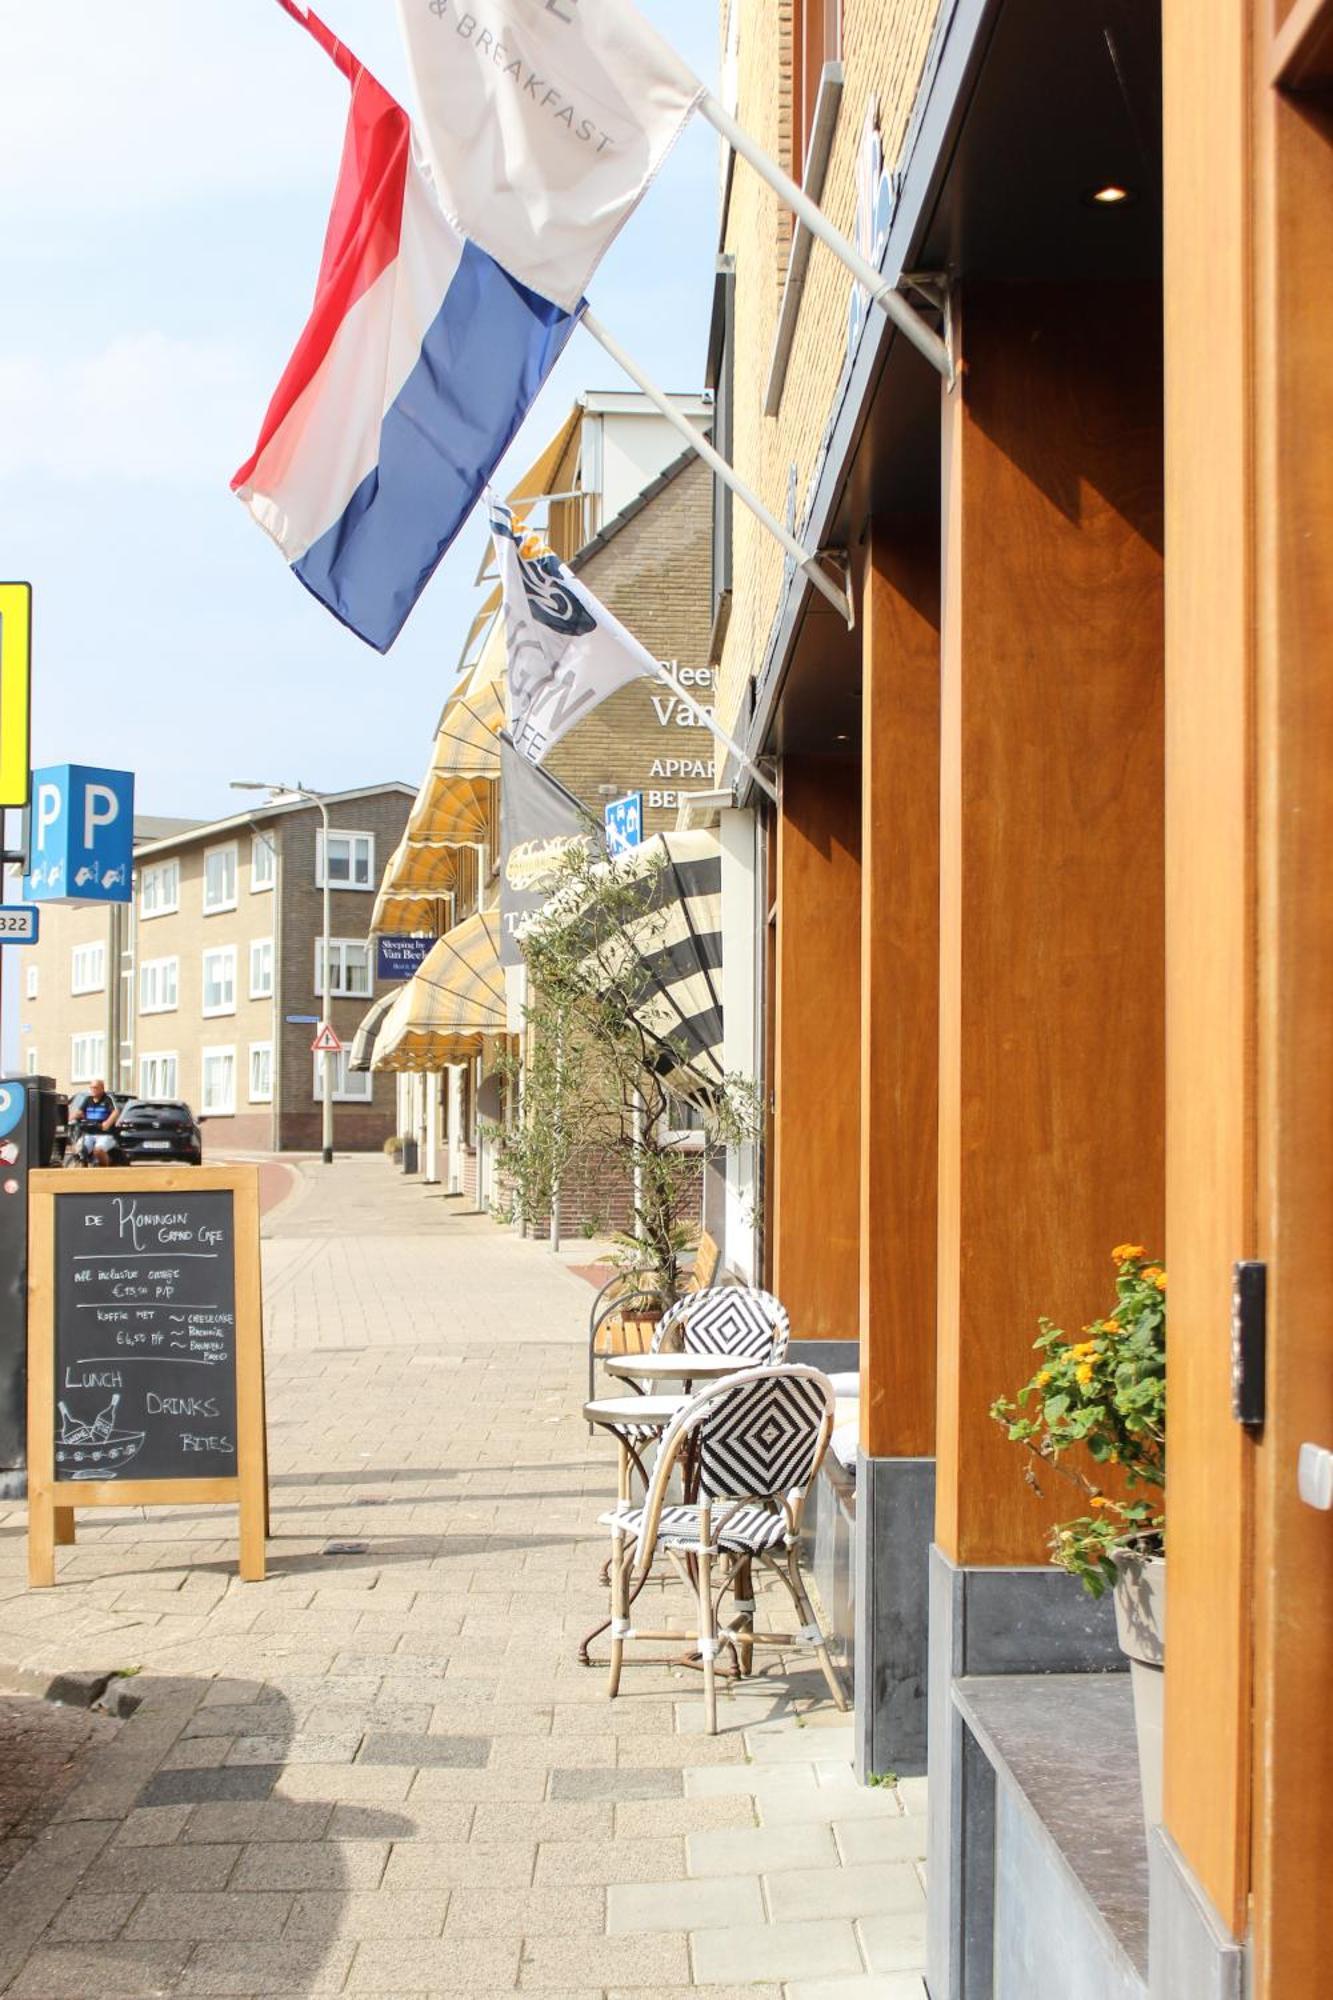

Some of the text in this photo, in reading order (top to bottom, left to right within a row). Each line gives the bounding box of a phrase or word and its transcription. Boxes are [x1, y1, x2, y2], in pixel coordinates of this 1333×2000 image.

[456, 13, 614, 152] BREAKFAST
[37, 783, 61, 851] P
[84, 783, 119, 849] P
[382, 948, 402, 960] Van
[84, 1197, 188, 1251] DE KONINGIN
[158, 1227, 193, 1243] GRAND
[65, 1366, 122, 1388] LUNCH
[146, 1392, 220, 1417] DRINKS
[179, 1433, 234, 1453] BITES
